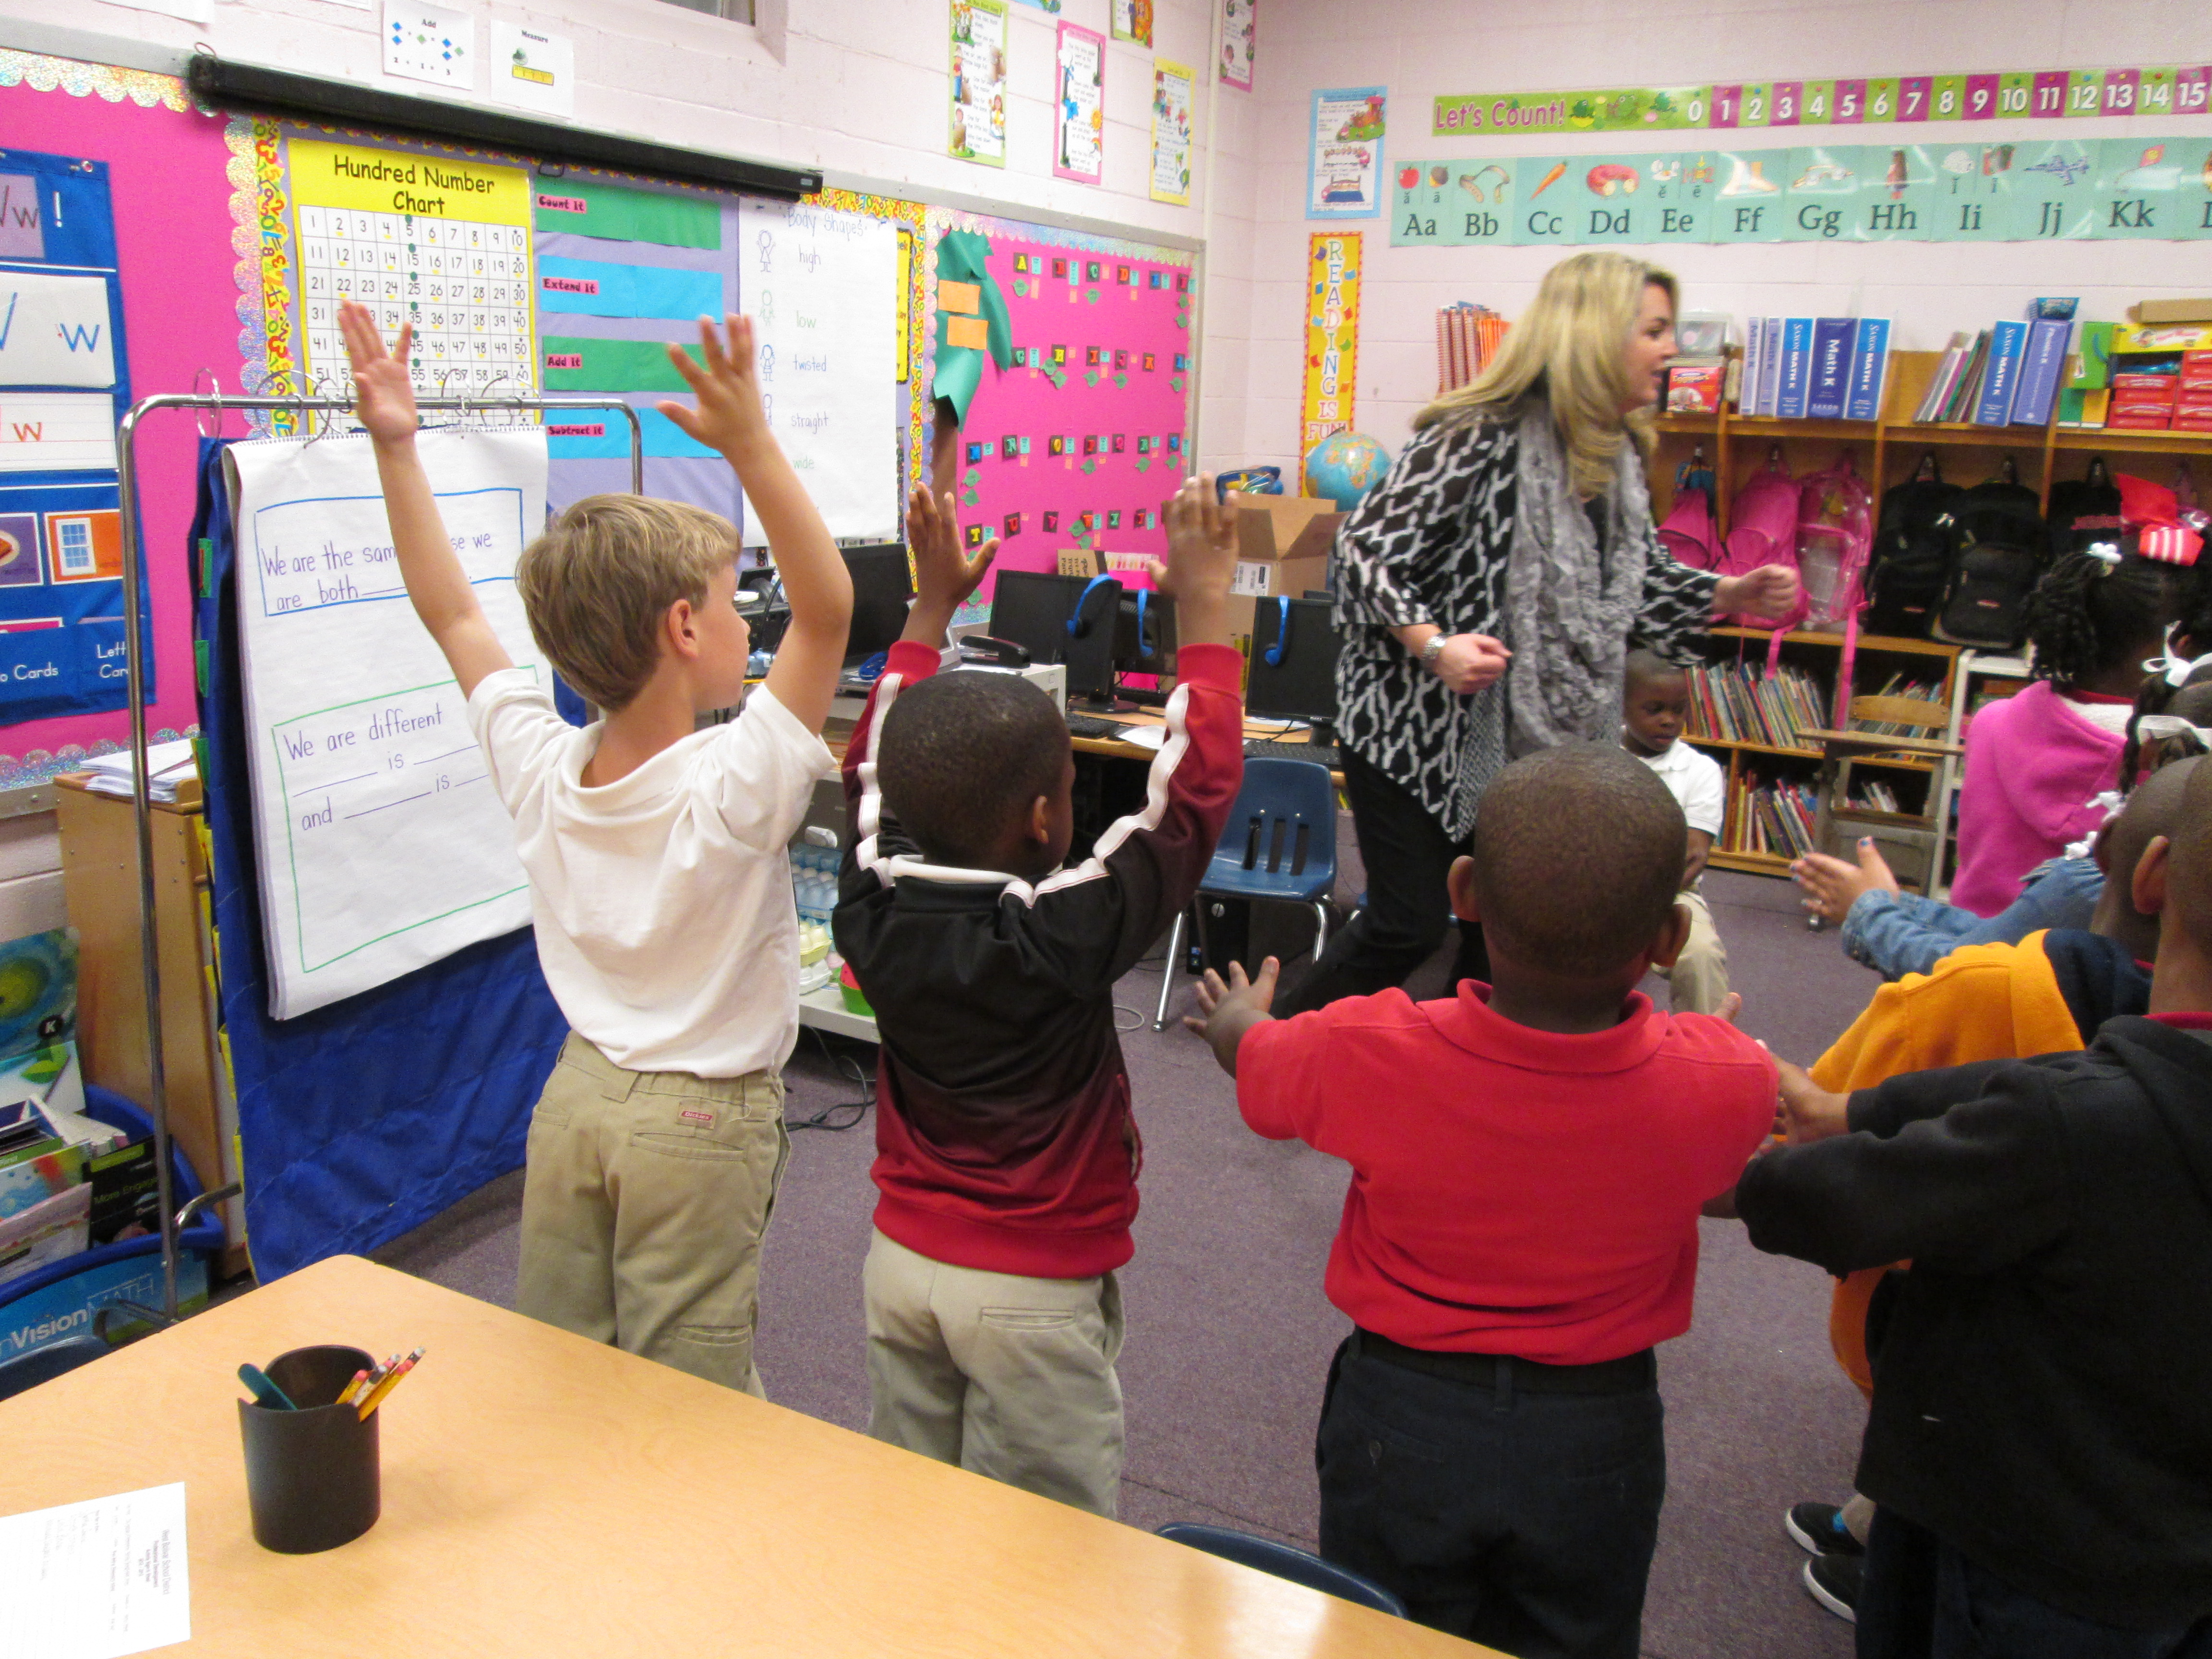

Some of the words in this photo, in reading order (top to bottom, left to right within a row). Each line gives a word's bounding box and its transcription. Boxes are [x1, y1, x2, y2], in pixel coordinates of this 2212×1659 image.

[422, 19, 436, 28] Add
[521, 29, 549, 44] Measure
[1435, 103, 1482, 129] Let's
[1491, 100, 1565, 128] Count!
[1688, 101, 1703, 121] 0
[1721, 100, 1730, 120] 1
[1749, 98, 1761, 120] 2
[1779, 96, 1793, 119] 3
[1809, 96, 1824, 117] 4
[1841, 94, 1856, 117] 5
[1874, 93, 1888, 115] 6
[1906, 92, 1922, 114] 7
[1939, 91, 1954, 113] 8
[1972, 89, 1988, 112] 9
[2002, 89, 2027, 112] 10
[2040, 87, 2060, 110] 11
[2072, 85, 2098, 109] 12
[2107, 84, 2133, 108] 13
[2143, 84, 2170, 107] 14
[2179, 83, 2206, 106] 15
[334, 155, 415, 184] Hundred
[424, 166, 494, 193] Number
[393, 191, 445, 214] Chart
[539, 196, 569, 209] Count
[573, 201, 584, 211] It
[312, 215, 315, 227] 1
[337, 217, 343, 230] 2
[360, 220, 366, 232] 3
[384, 222, 390, 233] 4
[406, 225, 413, 237] 5
[429, 227, 435, 239] 6
[451, 229, 457, 240] 7
[472, 231, 478, 242] 8
[493, 233, 499, 244] 9
[512, 235, 523, 246] 10
[787, 208, 817, 237] Body
[824, 212, 864, 240] Shapes
[1403, 214, 1437, 237] Aa
[1465, 213, 1499, 237] Bb
[1527, 211, 1562, 234] Cc
[1589, 209, 1630, 234] Dd
[1660, 209, 1694, 232] Ee
[1734, 207, 1765, 232] Ff
[1798, 204, 1843, 237] Gg
[1870, 203, 1917, 230] Hh
[1959, 204, 1982, 230] Ii
[2038, 202, 2064, 235] Jj
[2108, 201, 2156, 228] Kk
[311, 246, 322, 259] 11
[336, 249, 349, 261] 12
[361, 250, 373, 263] 13
[384, 252, 396, 264] 14
[407, 254, 419, 265] 15
[430, 256, 441, 268] 16
[451, 257, 462, 269] 17
[473, 259, 483, 271] 18
[493, 260, 504, 272] 19
[513, 262, 524, 274] 20
[799, 244, 821, 273] high
[1017, 255, 1027, 270] A
[1119, 268, 1128, 281] D
[312, 277, 324, 289] 21
[337, 279, 350, 291] 22
[361, 280, 374, 292] 23
[385, 282, 397, 294] 24
[409, 283, 421, 295] 25
[430, 285, 443, 296] 26
[452, 286, 464, 297] 27
[473, 287, 484, 299] 28
[494, 288, 505, 300] 29
[514, 289, 525, 301] 30
[543, 279, 581, 292] Extend
[584, 283, 596, 294] It
[312, 307, 325, 320] 31
[386, 311, 399, 323] 34
[409, 312, 422, 323] 35
[431, 313, 444, 324] 36
[452, 313, 465, 325] 37
[473, 314, 485, 326] 38
[494, 315, 505, 327] 39
[513, 316, 526, 327] 40
[796, 311, 817, 328] low
[1322, 241, 1343, 395] READING
[60, 323, 100, 353] w
[432, 341, 445, 352] 46
[453, 342, 465, 353] 47
[474, 342, 486, 353] 48
[495, 343, 507, 354] 49
[515, 343, 527, 354] 50
[547, 358, 566, 367] Add
[571, 358, 580, 367] It
[793, 355, 827, 372] twisted
[1091, 350, 1098, 362] I
[1789, 351, 1798, 380] MATH
[1825, 339, 1840, 374] Math
[1862, 353, 1874, 382] MATH
[1995, 357, 2008, 387] MATH
[1319, 401, 1336, 418] IS
[12, 421, 42, 442] w
[548, 426, 590, 435] Subtract
[593, 427, 603, 435] It
[791, 411, 829, 434] straight
[1054, 439, 1061, 452] O
[793, 456, 815, 469] wide
[971, 528, 980, 542] T
[1008, 517, 1018, 531] U
[261, 546, 287, 577] We
[292, 554, 315, 573] are
[322, 540, 354, 570] the
[362, 544, 397, 563] sam
[473, 532, 492, 548] we
[276, 593, 302, 612] are
[318, 574, 359, 604] both
[97, 641, 126, 659] Lett
[13, 661, 59, 680] Cards
[99, 664, 128, 678] Car
[284, 731, 313, 760] We
[327, 731, 356, 751] are
[369, 702, 443, 740] different
[388, 752, 404, 769] is
[301, 796, 333, 830] and
[435, 775, 450, 792] is
[45, 1020, 56, 1034] K
[685, 1112, 709, 1120] Dickies
